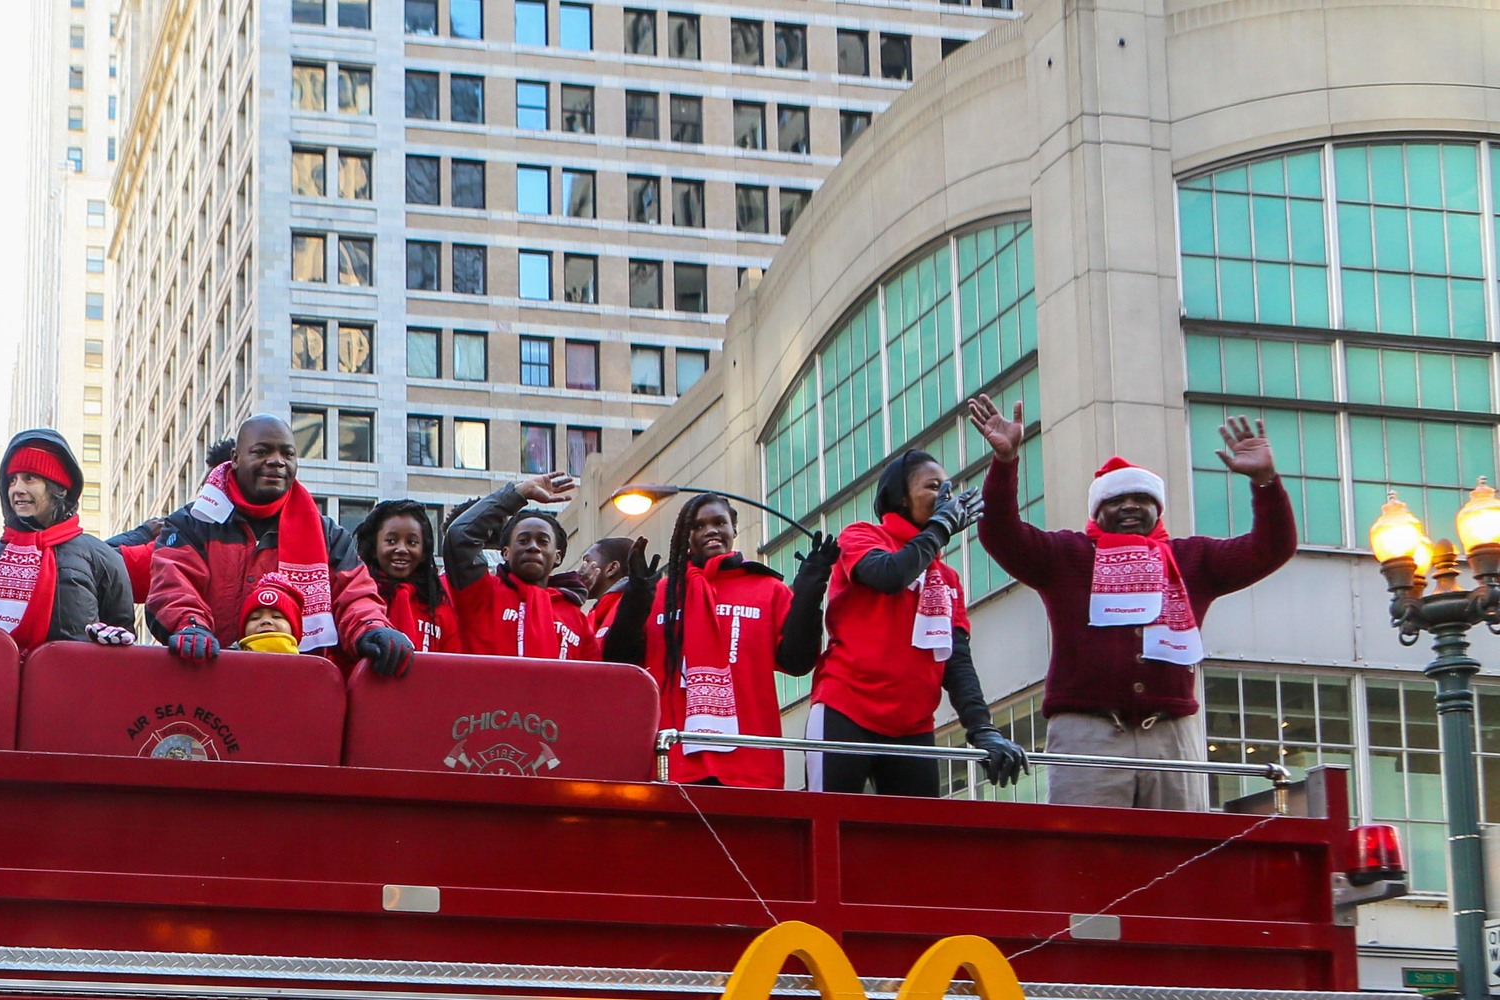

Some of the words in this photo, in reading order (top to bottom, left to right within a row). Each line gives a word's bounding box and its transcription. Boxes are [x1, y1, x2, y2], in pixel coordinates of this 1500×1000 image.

[732, 605, 761, 619] CLUB
[127, 715, 150, 740] AIR
[154, 704, 185, 719] SEA
[193, 706, 240, 754] RESCUE
[451, 710, 559, 742] CHICAGO
[489, 748, 516, 760] FIRE
